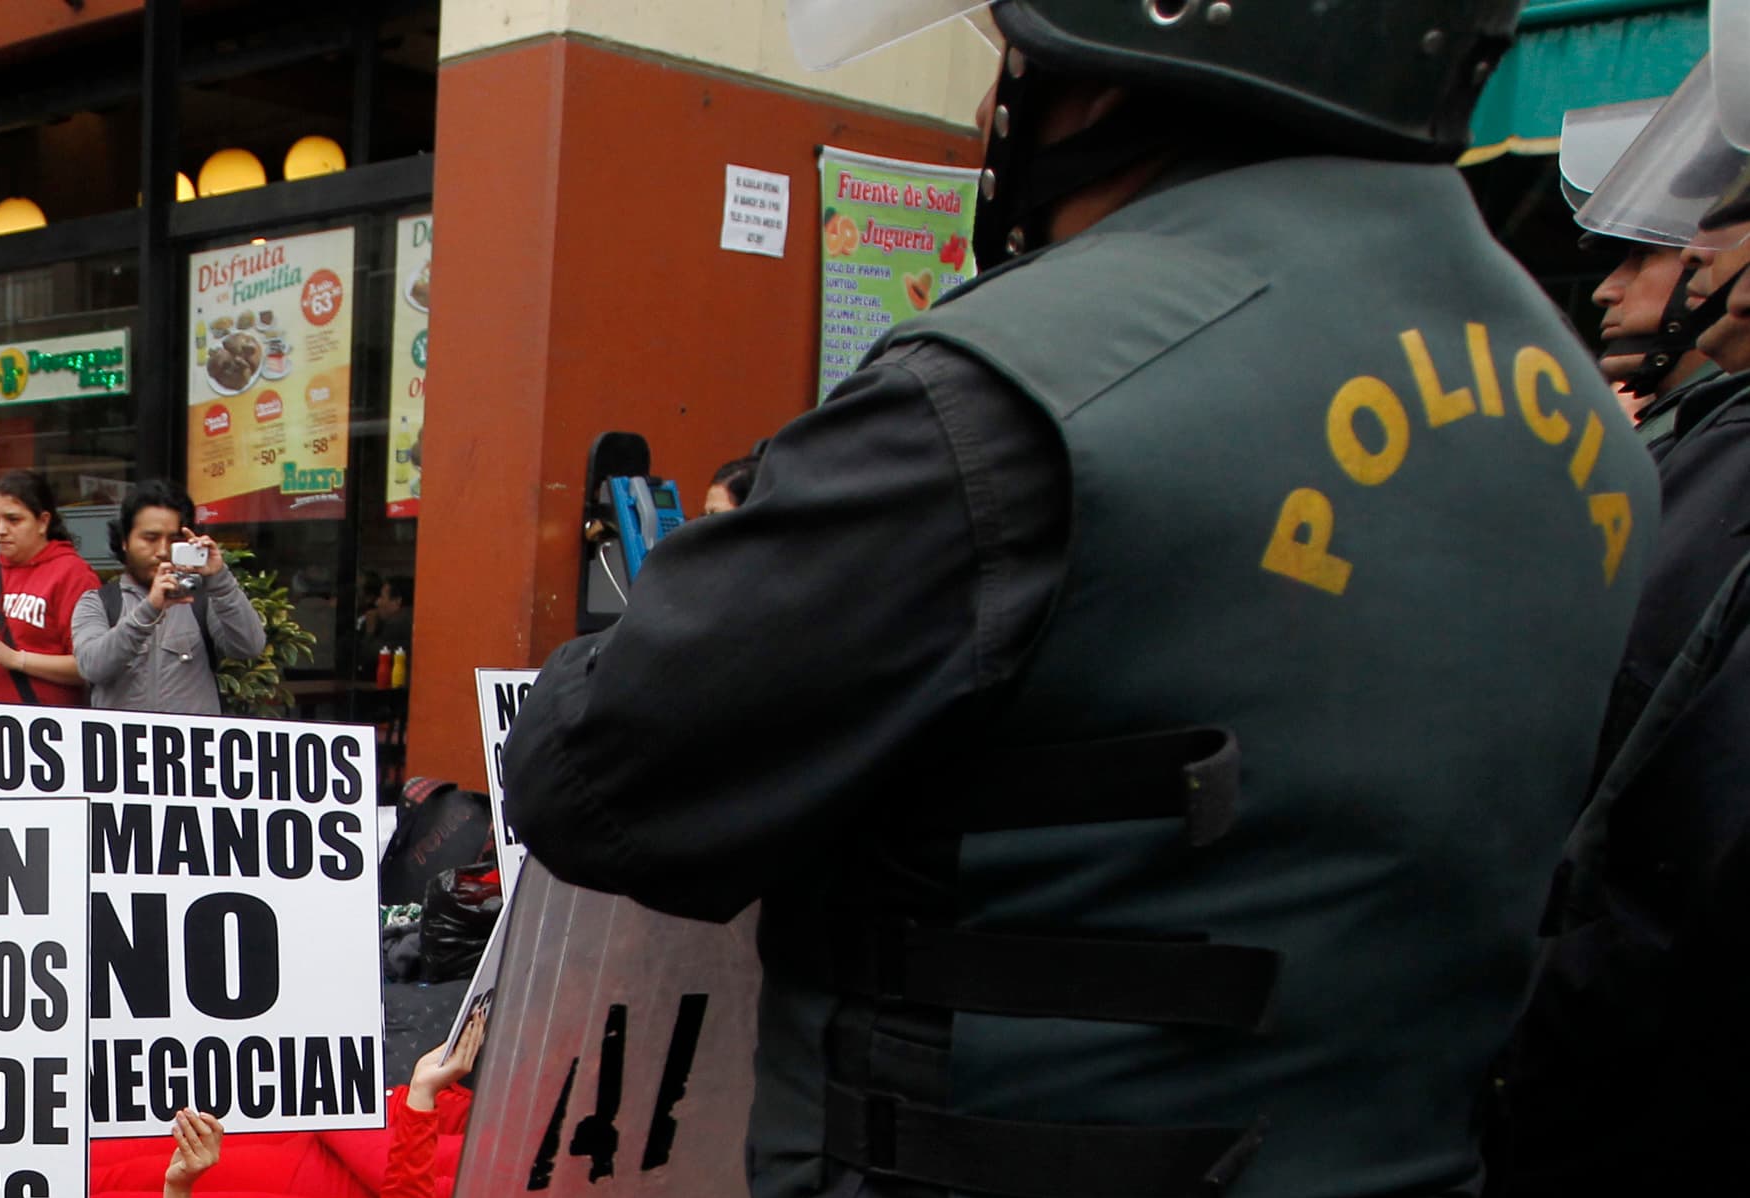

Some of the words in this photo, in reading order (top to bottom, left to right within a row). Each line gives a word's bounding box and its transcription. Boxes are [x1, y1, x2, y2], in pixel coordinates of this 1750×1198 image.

[837, 171, 899, 206] Fuente
[903, 183, 923, 208] de
[926, 185, 962, 214] Soda
[198, 245, 285, 292] Disfruta
[232, 264, 302, 306] Familia
[1261, 322, 1632, 595] POLICIA
[82, 720, 362, 804] DERECHOS
[91, 801, 363, 881] MANOS
[91, 891, 280, 1020] NO
[91, 1035, 375, 1124] NEGOCIAN
